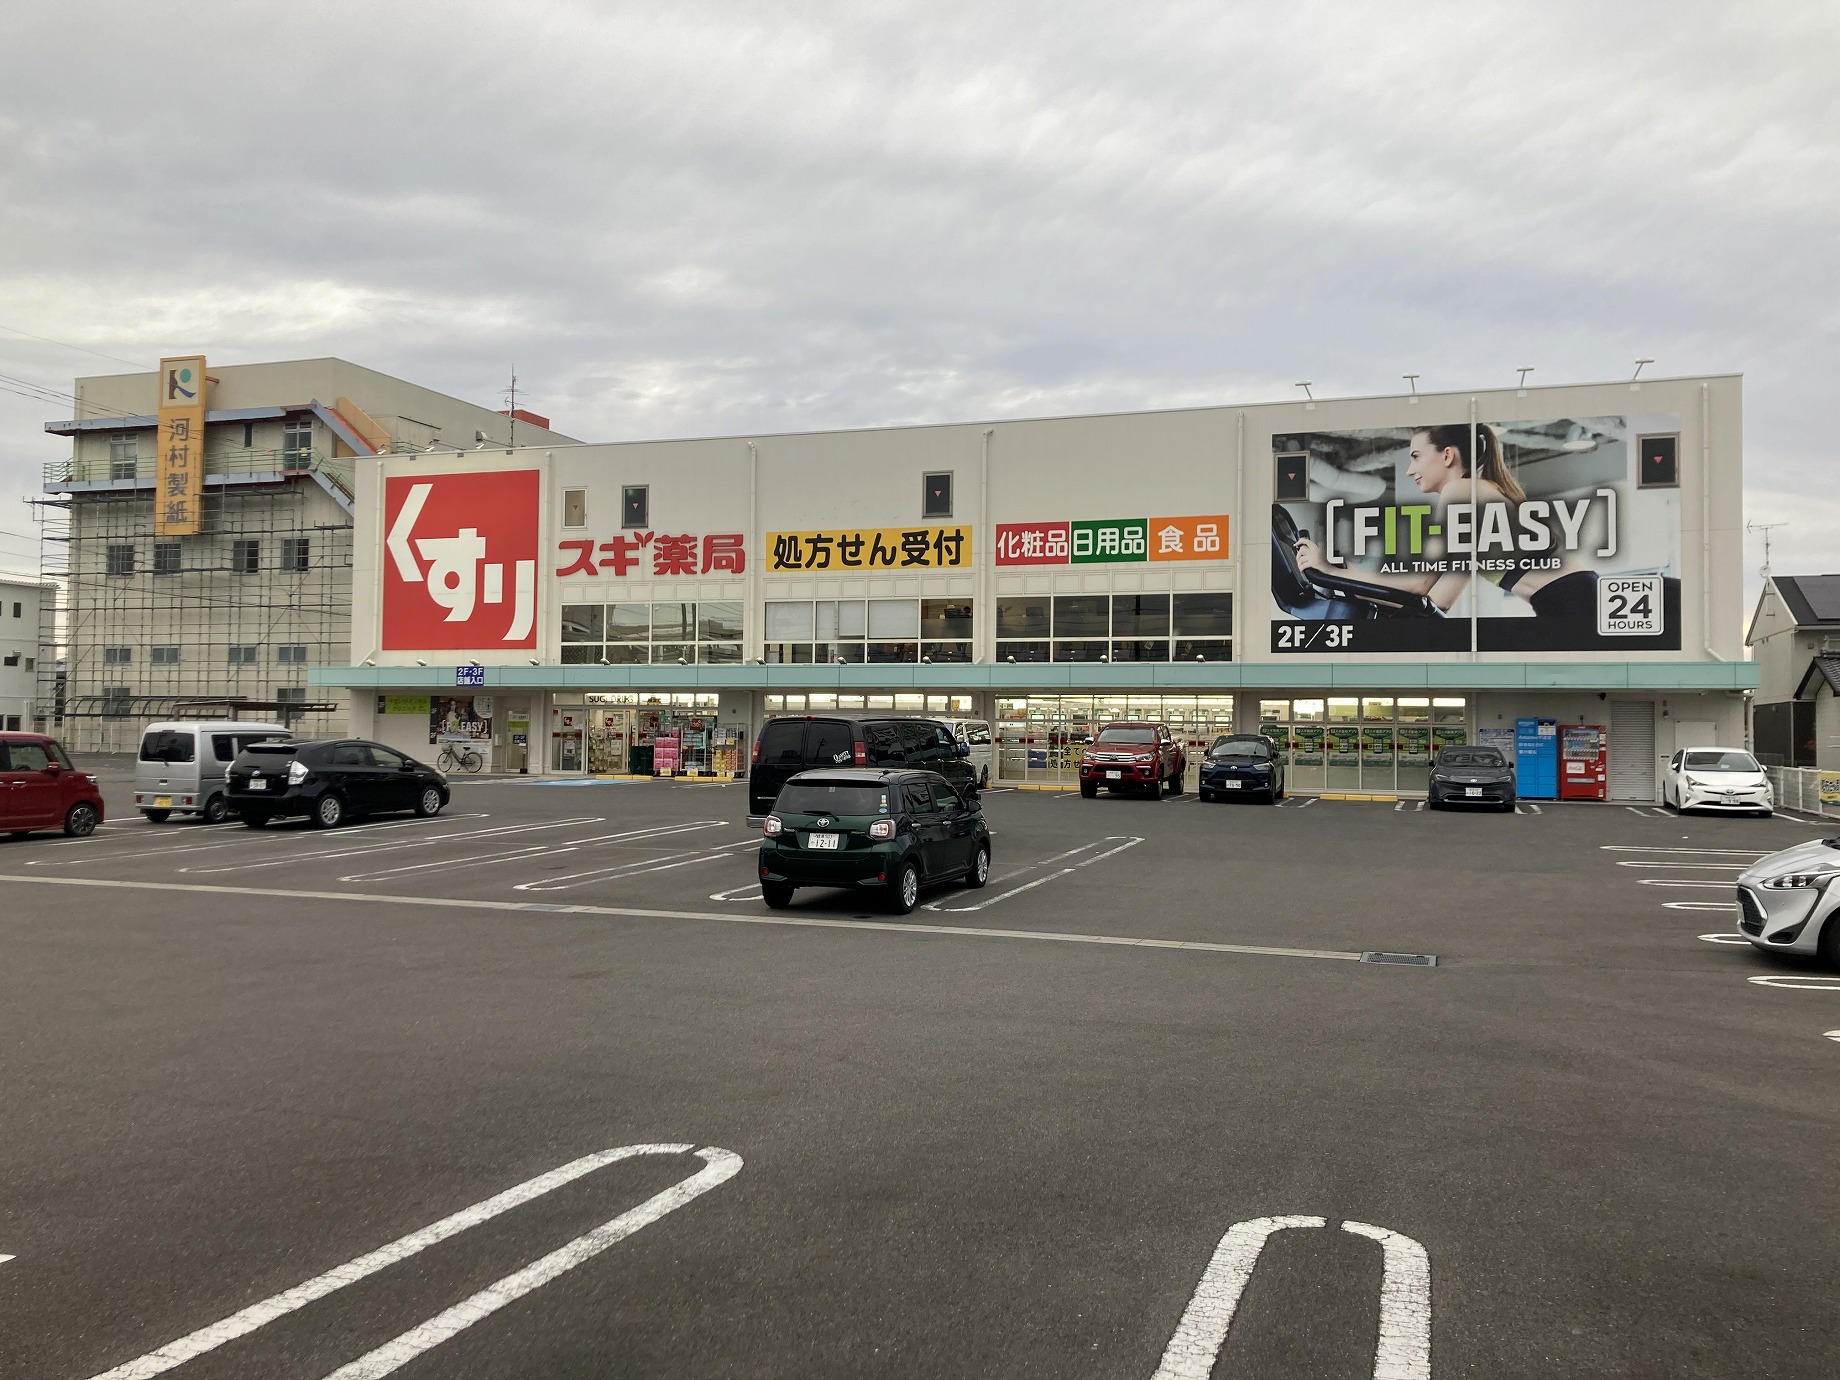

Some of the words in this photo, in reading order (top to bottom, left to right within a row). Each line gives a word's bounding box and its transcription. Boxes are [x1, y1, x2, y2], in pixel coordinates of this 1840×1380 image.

[166, 417, 191, 525] 河村製紙
[555, 531, 747, 577] スギ薬局
[773, 529, 965, 570] 処方せん受付
[997, 528, 1068, 560] 化粧品
[1072, 526, 1146, 557] 日用品
[386, 483, 536, 641] くすり
[1379, 560, 1409, 574] ALL
[1411, 559, 1448, 573] TIME
[1452, 558, 1516, 572] FITNESS
[1519, 557, 1562, 571] CLUB
[1607, 581, 1654, 595] OPEN
[1607, 594, 1654, 620] 24
[1607, 619, 1654, 631] HOURS
